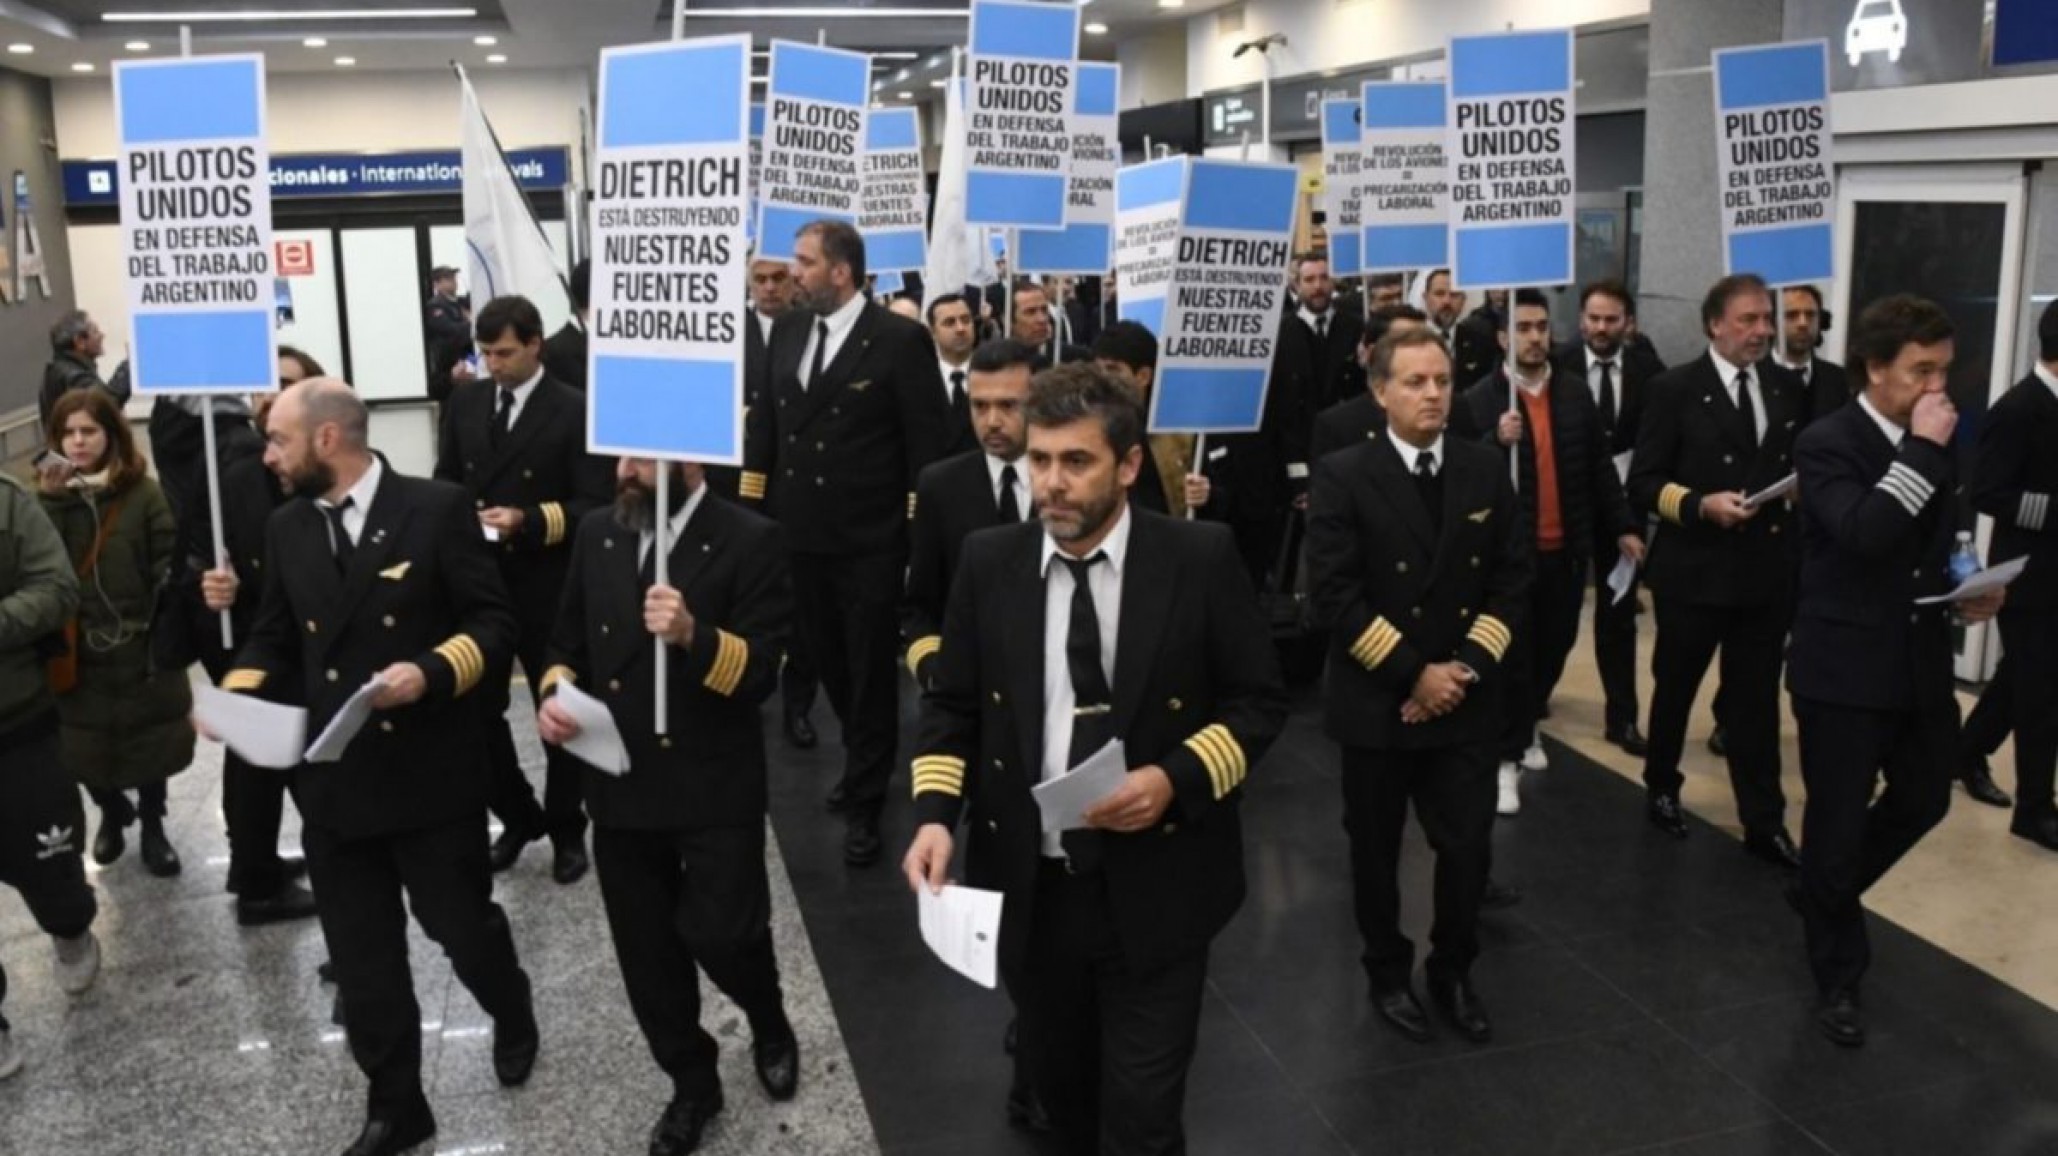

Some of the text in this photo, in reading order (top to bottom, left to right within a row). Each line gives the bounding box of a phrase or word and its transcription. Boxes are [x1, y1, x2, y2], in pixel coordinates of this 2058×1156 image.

[975, 60, 1069, 89] PILOTOS
[978, 86, 1063, 113] UNIDOS
[773, 99, 860, 132] PILOTOS
[973, 113, 1065, 133] EN DEFENSA
[1457, 97, 1565, 129] PILOTOS
[1725, 105, 1823, 139] PILOTOS
[776, 125, 854, 155] UNIDOS
[967, 131, 1069, 152] DEL TRABAJO
[1373, 143, 1442, 156] REVOLUCIÓN
[1462, 127, 1561, 158] UNIDOS
[1732, 134, 1819, 165] UNIDOS
[129, 145, 257, 184] PILOTOS
[770, 150, 856, 175] EN DEFENSA
[863, 152, 919, 171] ETRICH
[974, 151, 1060, 169] ARGENTINO
[1073, 148, 1114, 161] VIONES
[1363, 158, 1376, 169] DE
[1380, 157, 1402, 169] LOS
[269, 159, 543, 186] cionales Internation vals
[601, 157, 740, 199] DIETRICH
[765, 168, 790, 184] DEL
[796, 171, 860, 193] TRABAJO
[1458, 158, 1565, 181] EN DEFENSA
[1729, 162, 1825, 188] EN DEFENSA
[1069, 176, 1112, 191] ZACIÓN
[1453, 178, 1571, 202] DEL TRABAJO
[1725, 181, 1831, 208] DEL TRABAJO
[137, 185, 252, 221] UNIDOS
[769, 187, 851, 209] ARGENTINO
[864, 199, 912, 212] UENTES
[1068, 192, 1096, 207] RAL
[1378, 196, 1434, 210] LABORAL
[1462, 199, 1562, 222] ARGENTINO
[599, 203, 739, 228] ESTÁ DESTRUYENDO
[1734, 201, 1823, 226] ARGENTINO
[133, 224, 260, 251] EN DEFENSA
[605, 234, 730, 265] NUESTRAS
[1178, 236, 1288, 267] DIETRICH
[129, 251, 268, 278] DEL TRABAJO
[1174, 267, 1283, 286] ESTÁ DESTRUYENDO
[141, 279, 257, 304] ARGENTINO
[612, 272, 718, 304] FUENTES
[1177, 287, 1274, 310] NUESTRAS
[596, 308, 735, 344] LABORALES
[1181, 311, 1263, 334] FUENTES
[1165, 336, 1271, 358] LABORALES
